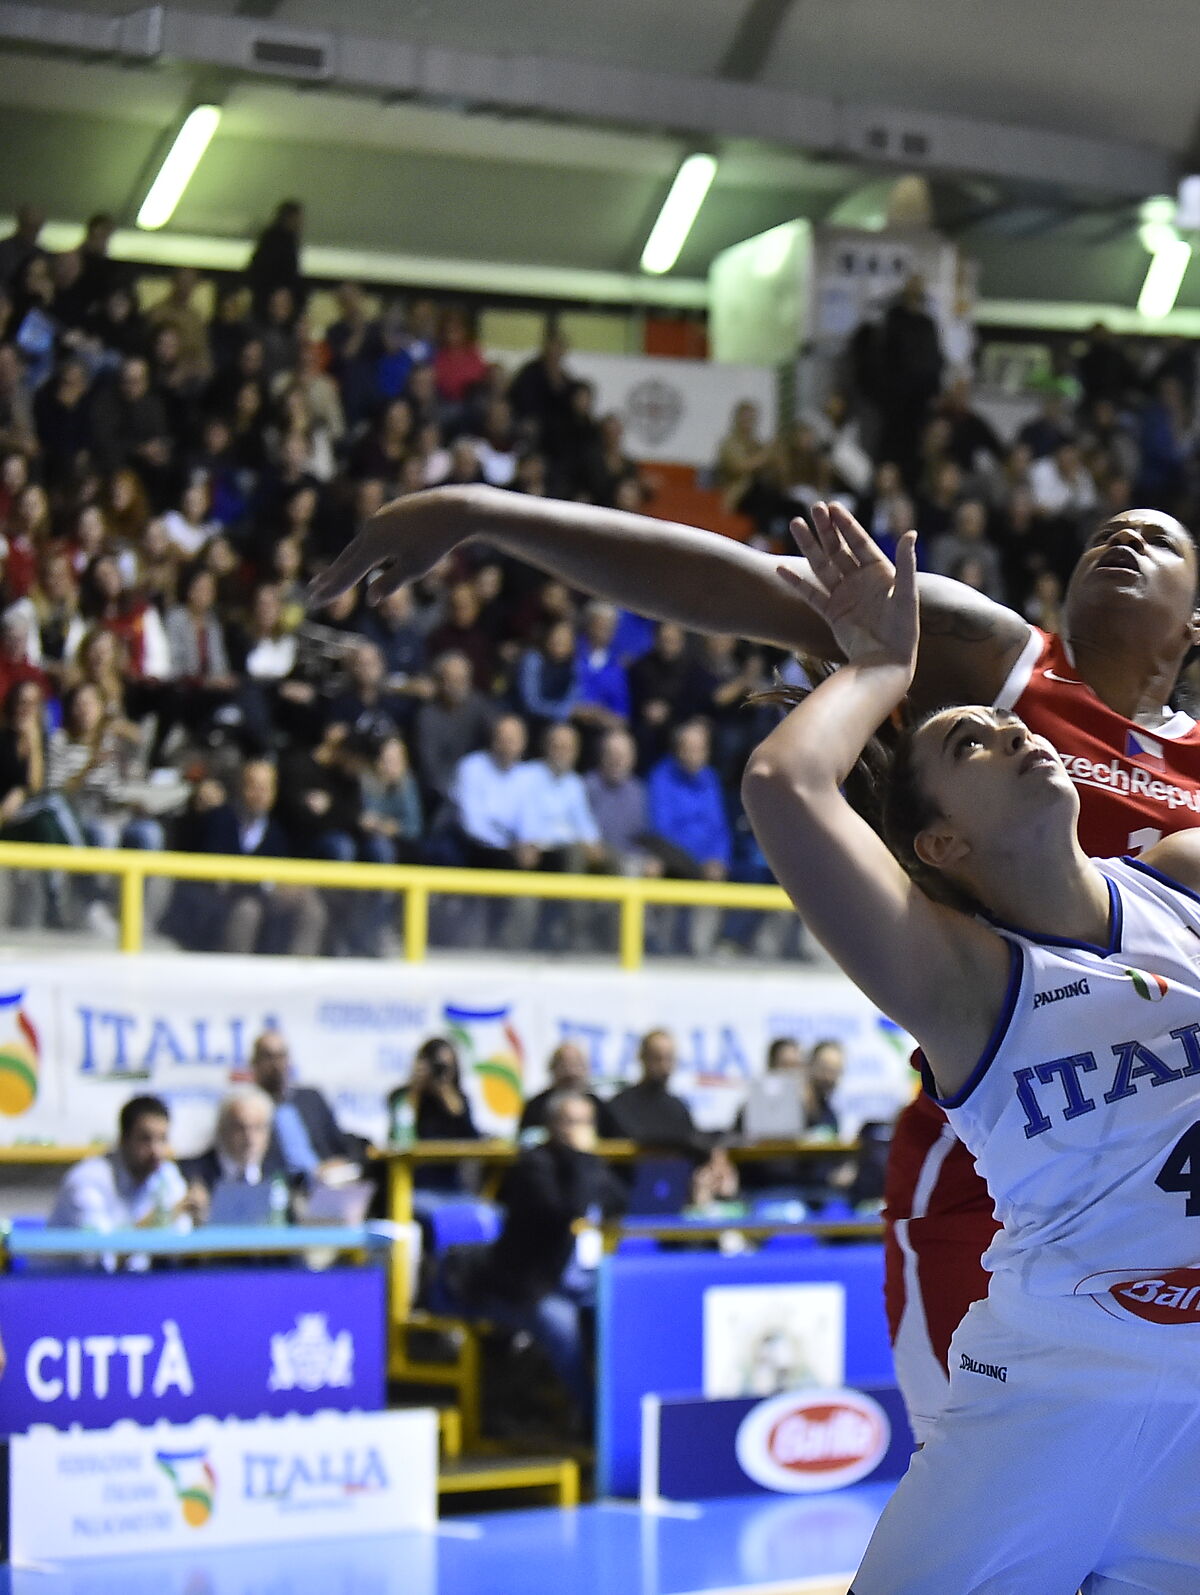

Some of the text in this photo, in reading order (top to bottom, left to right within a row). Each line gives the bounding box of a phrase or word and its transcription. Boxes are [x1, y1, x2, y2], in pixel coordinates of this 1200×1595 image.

[1032, 977, 1091, 1010] PALDING
[25, 1318, 195, 1403] CITTÀ
[959, 1353, 1008, 1384] SPALDING
[242, 1448, 389, 1499] ITALIA
